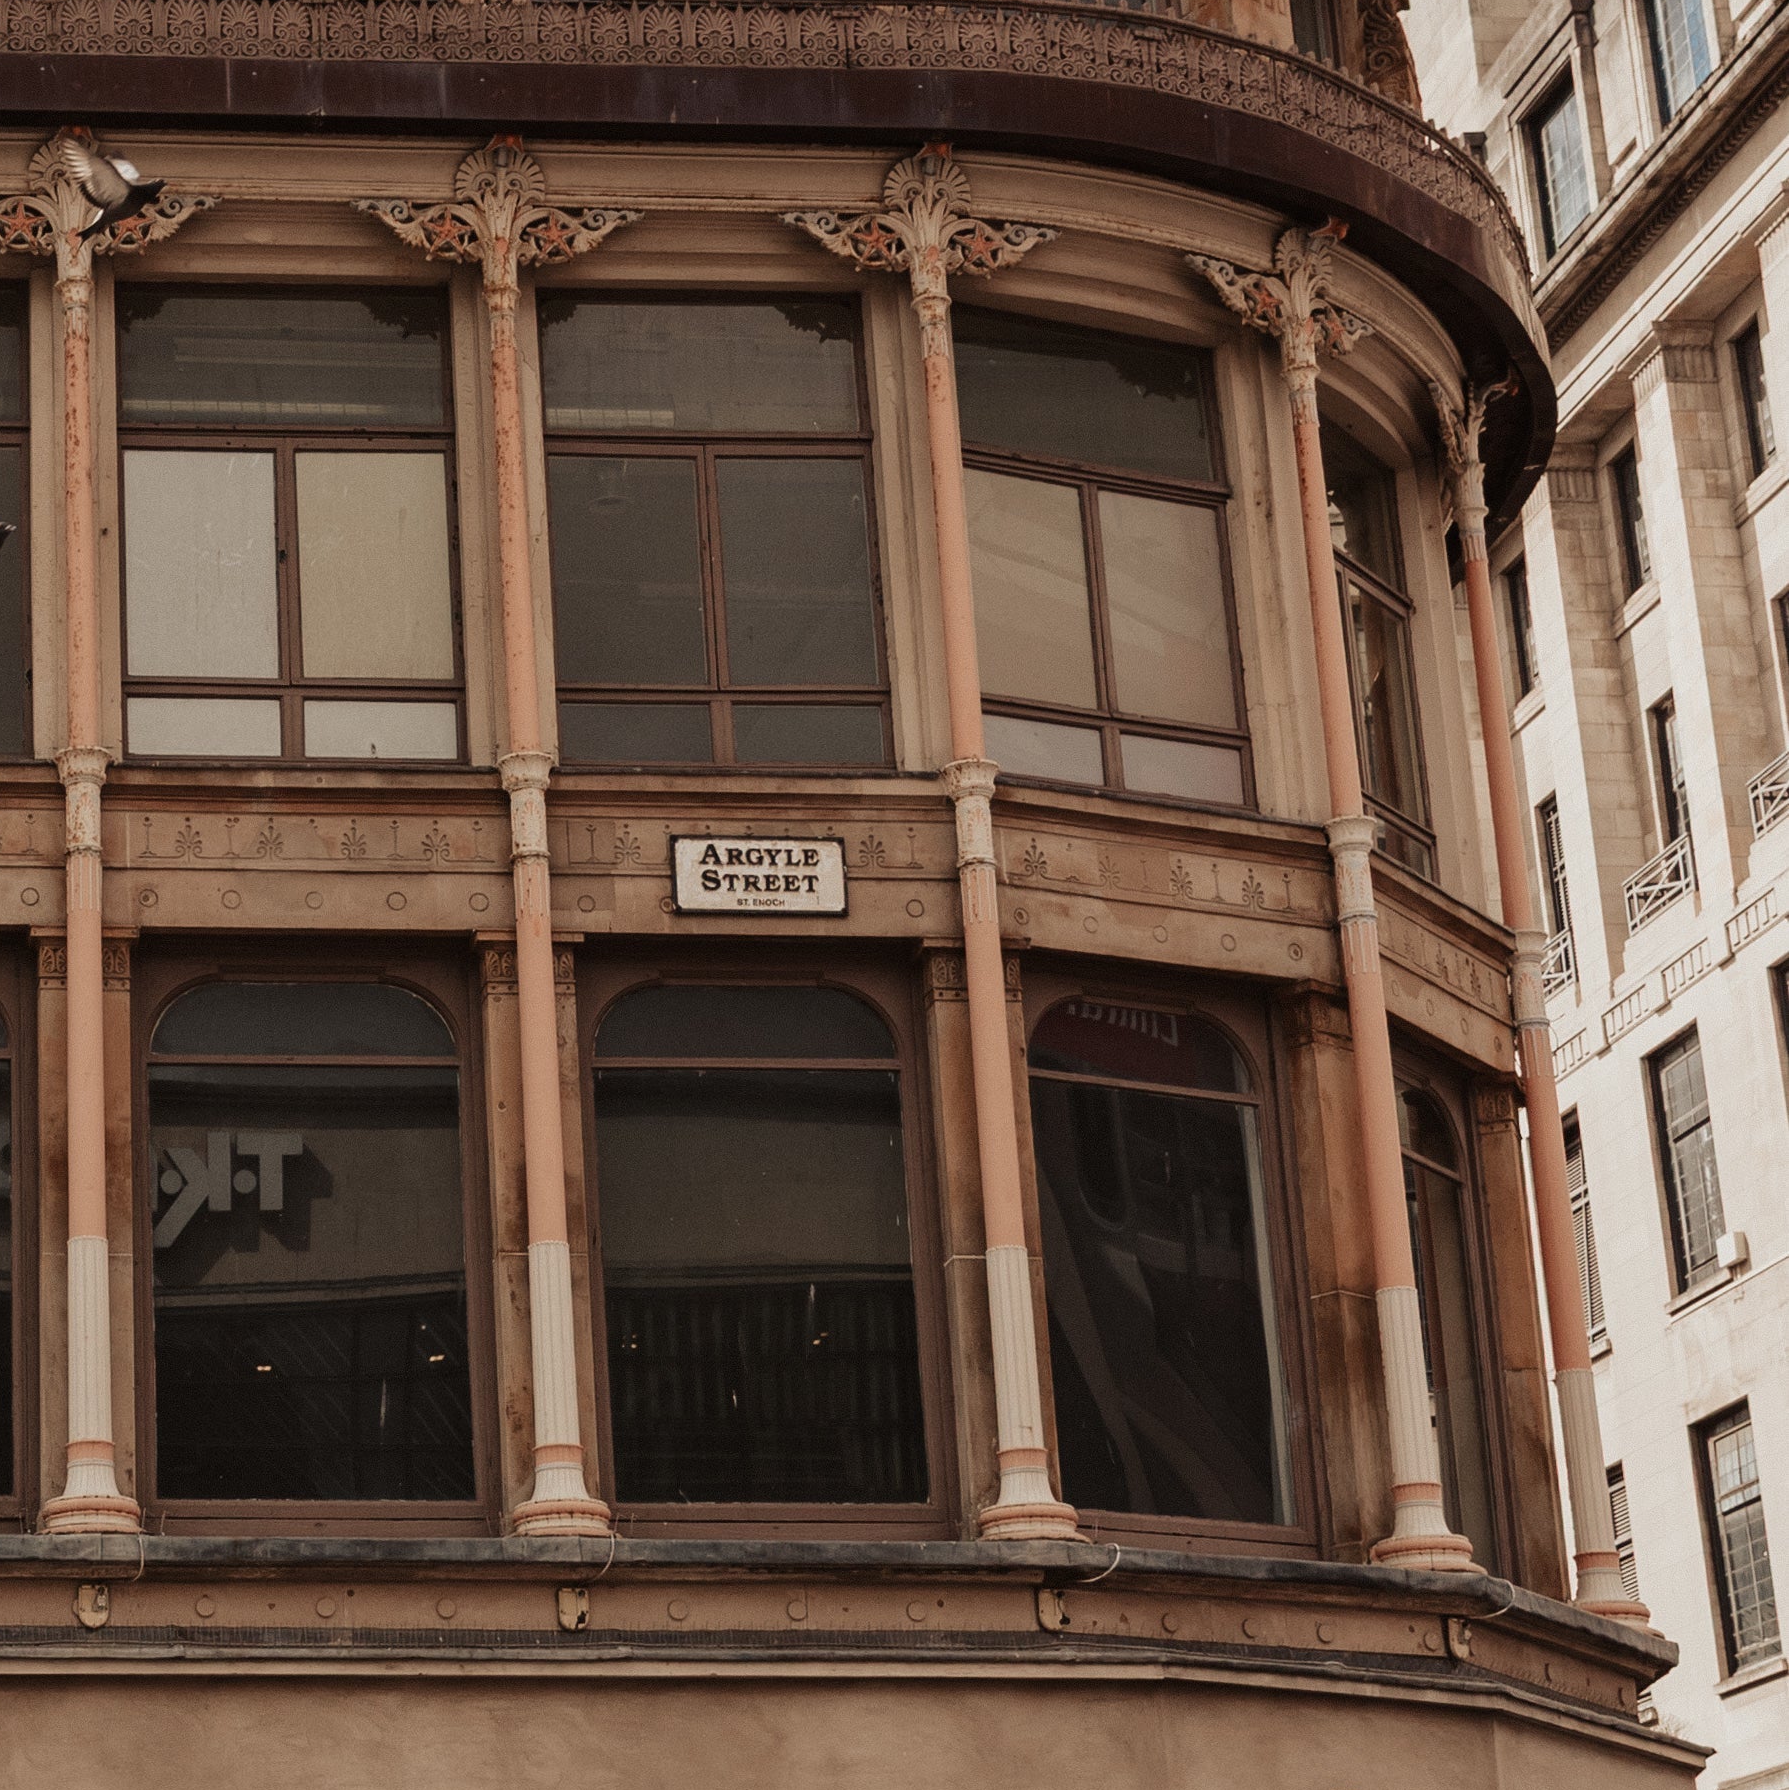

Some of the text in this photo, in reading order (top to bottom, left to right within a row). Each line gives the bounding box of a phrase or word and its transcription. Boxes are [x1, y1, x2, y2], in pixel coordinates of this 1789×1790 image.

[699, 844, 820, 867] ARGYLE
[701, 870, 820, 893] STREET
[736, 898, 786, 907] ST. ENOCH
